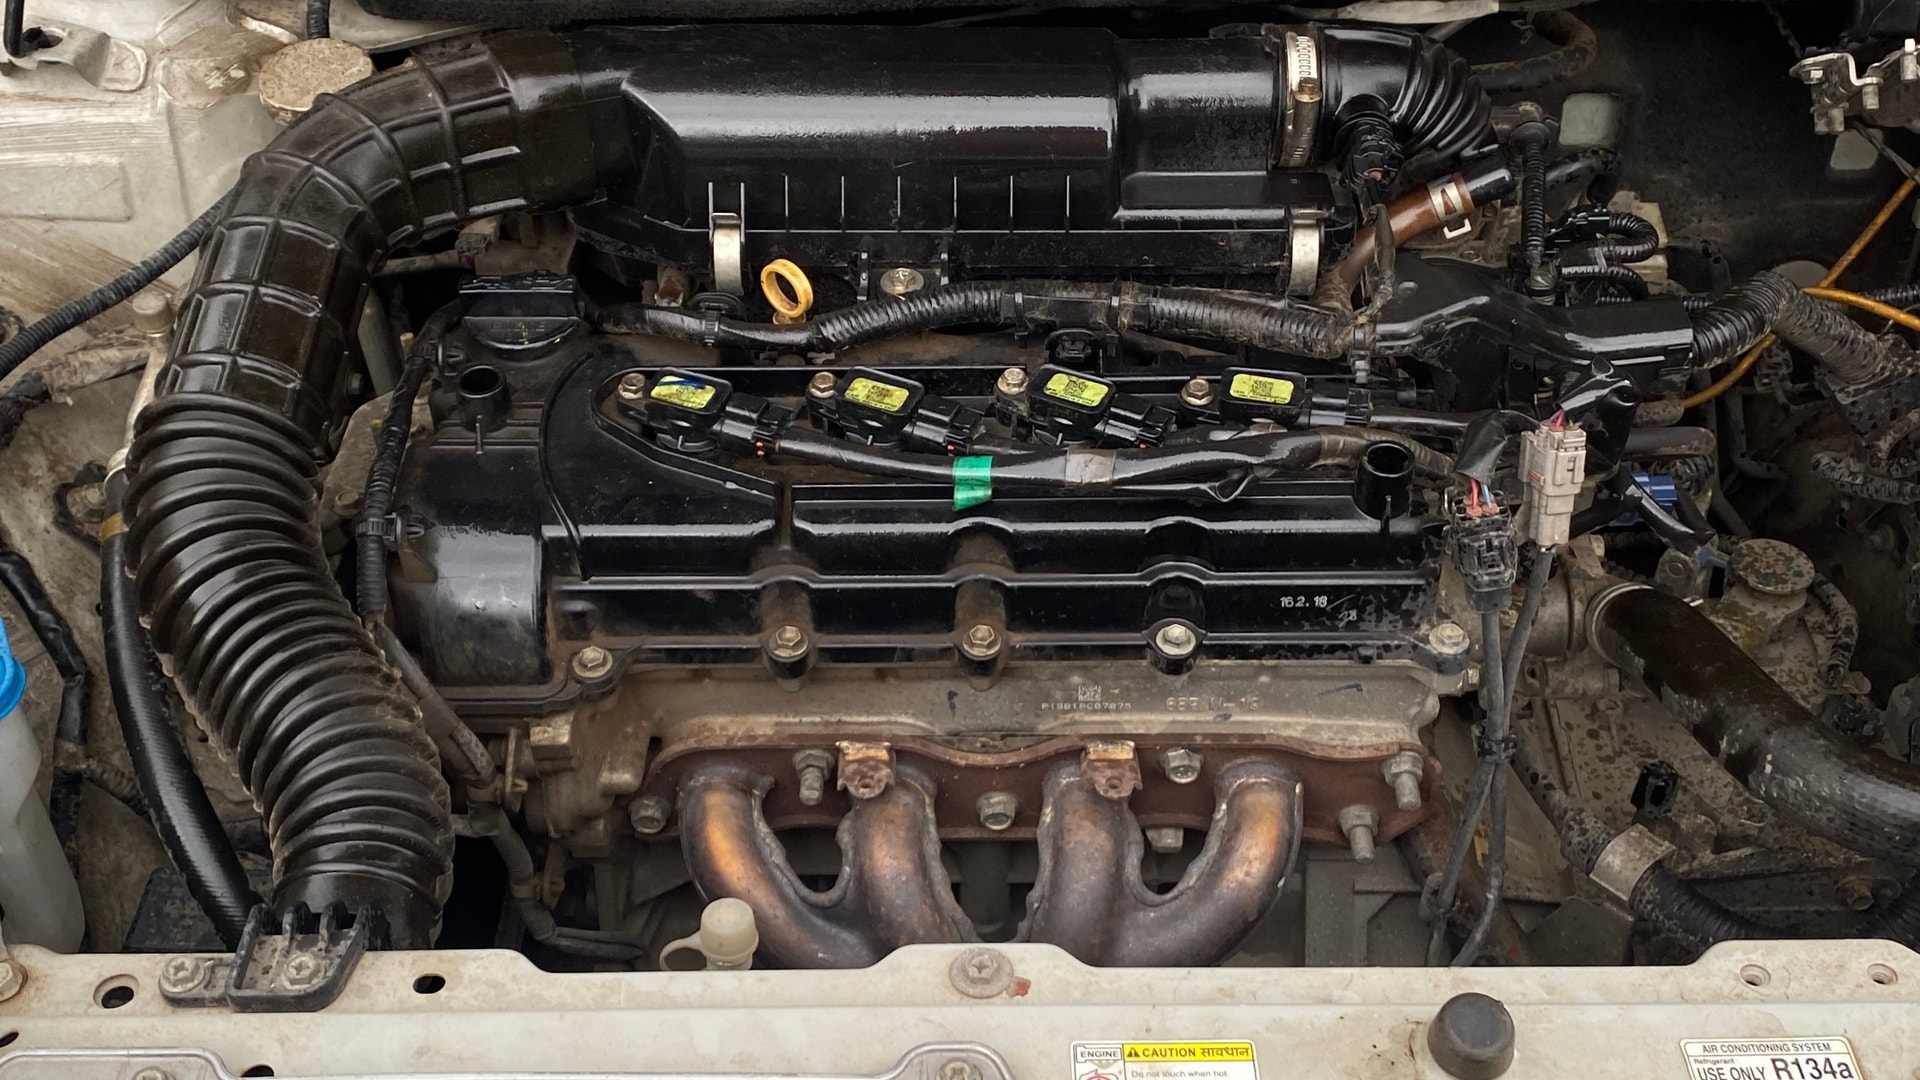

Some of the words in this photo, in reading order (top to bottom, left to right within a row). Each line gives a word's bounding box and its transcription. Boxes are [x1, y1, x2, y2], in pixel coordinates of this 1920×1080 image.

[1142, 1047, 1196, 1058] CAUTION
[1200, 1047, 1250, 1058] सावधान
[1702, 1044, 1719, 1054] AIR
[1720, 1043, 1791, 1054] CONDITIONING
[1792, 1042, 1832, 1052] SYSTEM
[1080, 1050, 1120, 1058] ENGINE
[1693, 1058, 1736, 1066] Refrigerant
[1131, 1070, 1144, 1078] Do
[1146, 1070, 1160, 1078] not
[1162, 1070, 1186, 1078] touch
[1188, 1070, 1212, 1078] when
[1696, 1067, 1728, 1080] USE
[1729, 1066, 1766, 1080] ONLY
[1770, 1057, 1854, 1080] R134a
